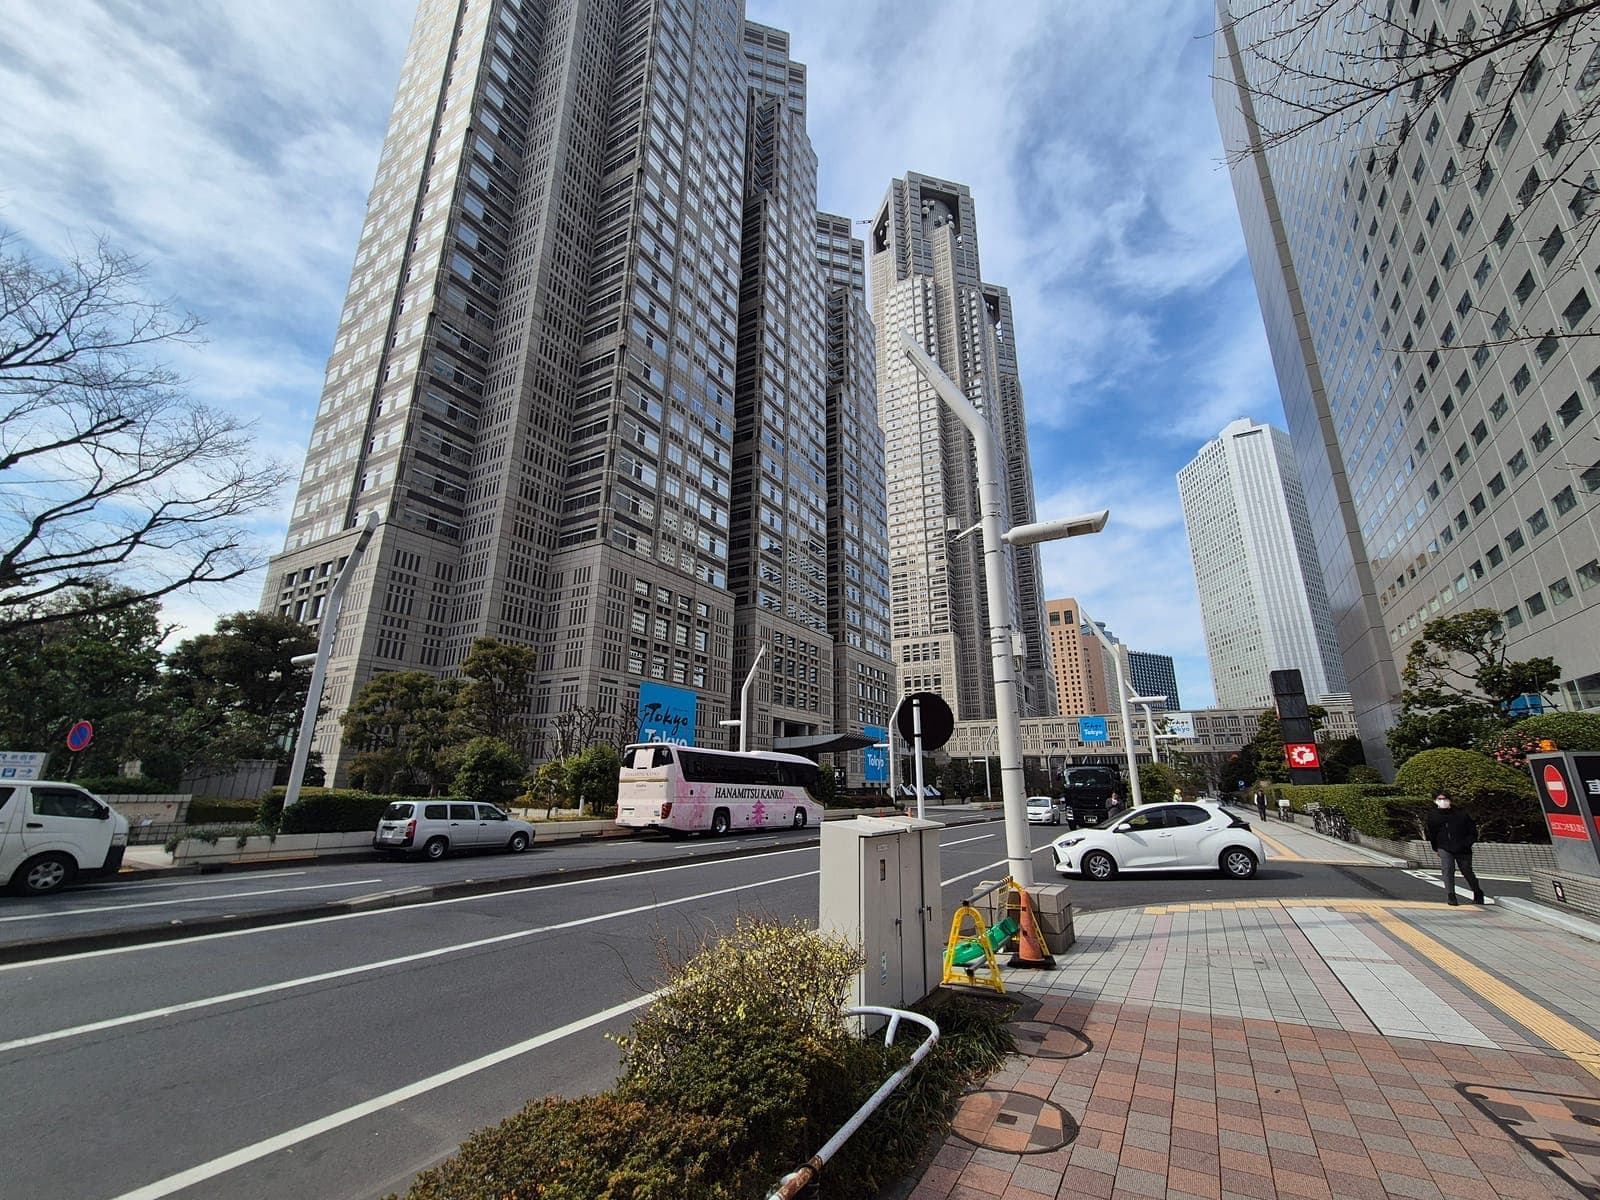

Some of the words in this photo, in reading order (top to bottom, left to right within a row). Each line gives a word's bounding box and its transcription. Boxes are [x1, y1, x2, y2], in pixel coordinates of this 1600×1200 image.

[647, 703, 688, 735] Tokyo
[1084, 729, 1103, 737] Tokyo
[867, 754, 884, 770] Tokyo
[715, 787, 760, 799] HANAMITSU
[760, 789, 785, 799] KANKO
